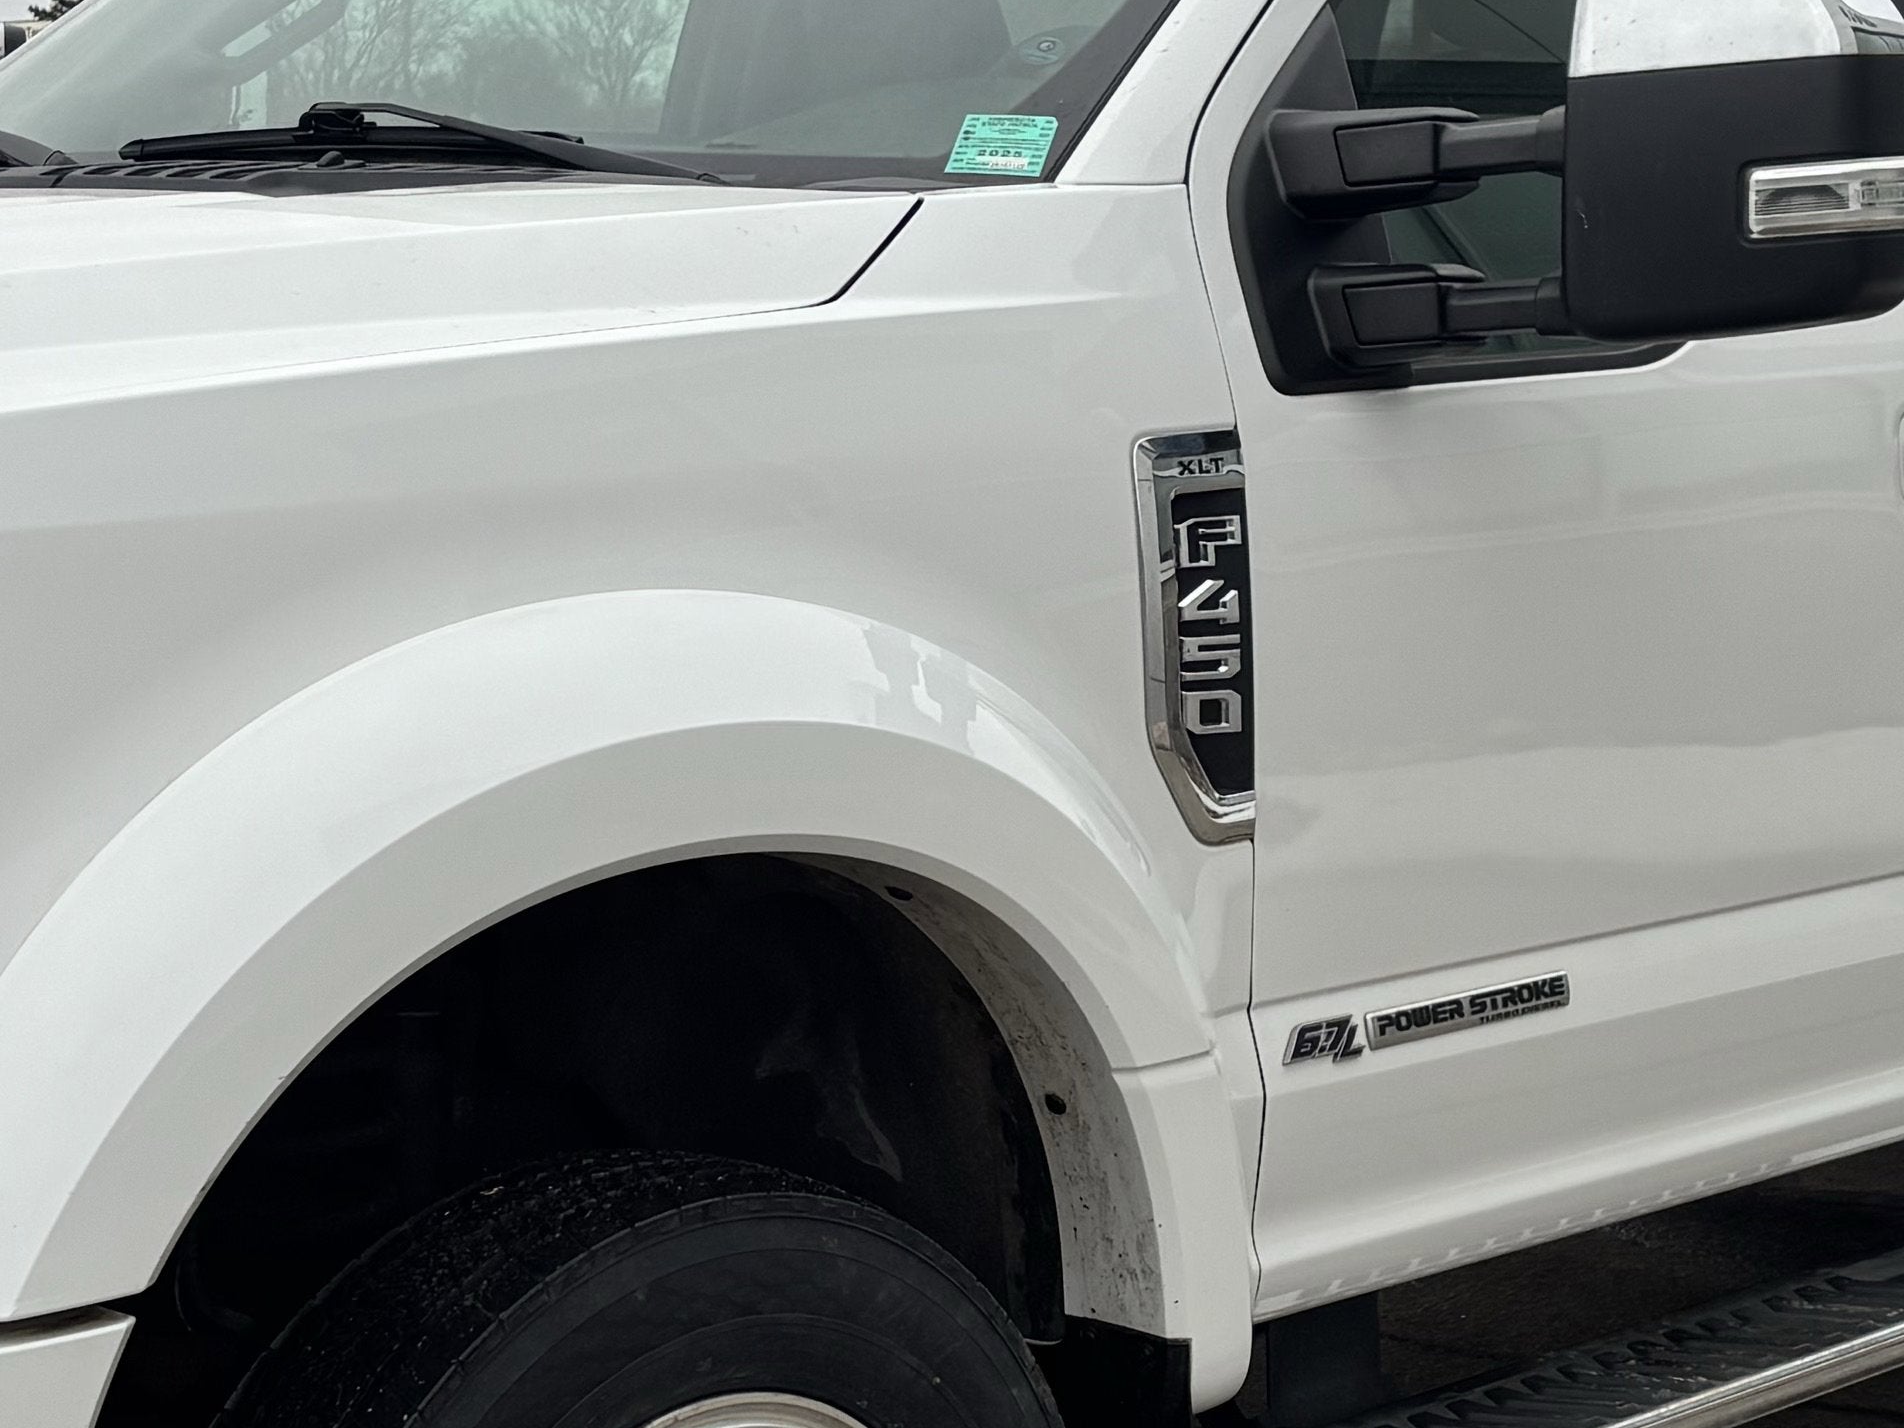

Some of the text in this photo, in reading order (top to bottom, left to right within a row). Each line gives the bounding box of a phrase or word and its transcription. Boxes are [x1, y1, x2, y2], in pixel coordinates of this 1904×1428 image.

[1177, 458, 1225, 476] XLT
[1376, 976, 1566, 1037] POWER STROKE
